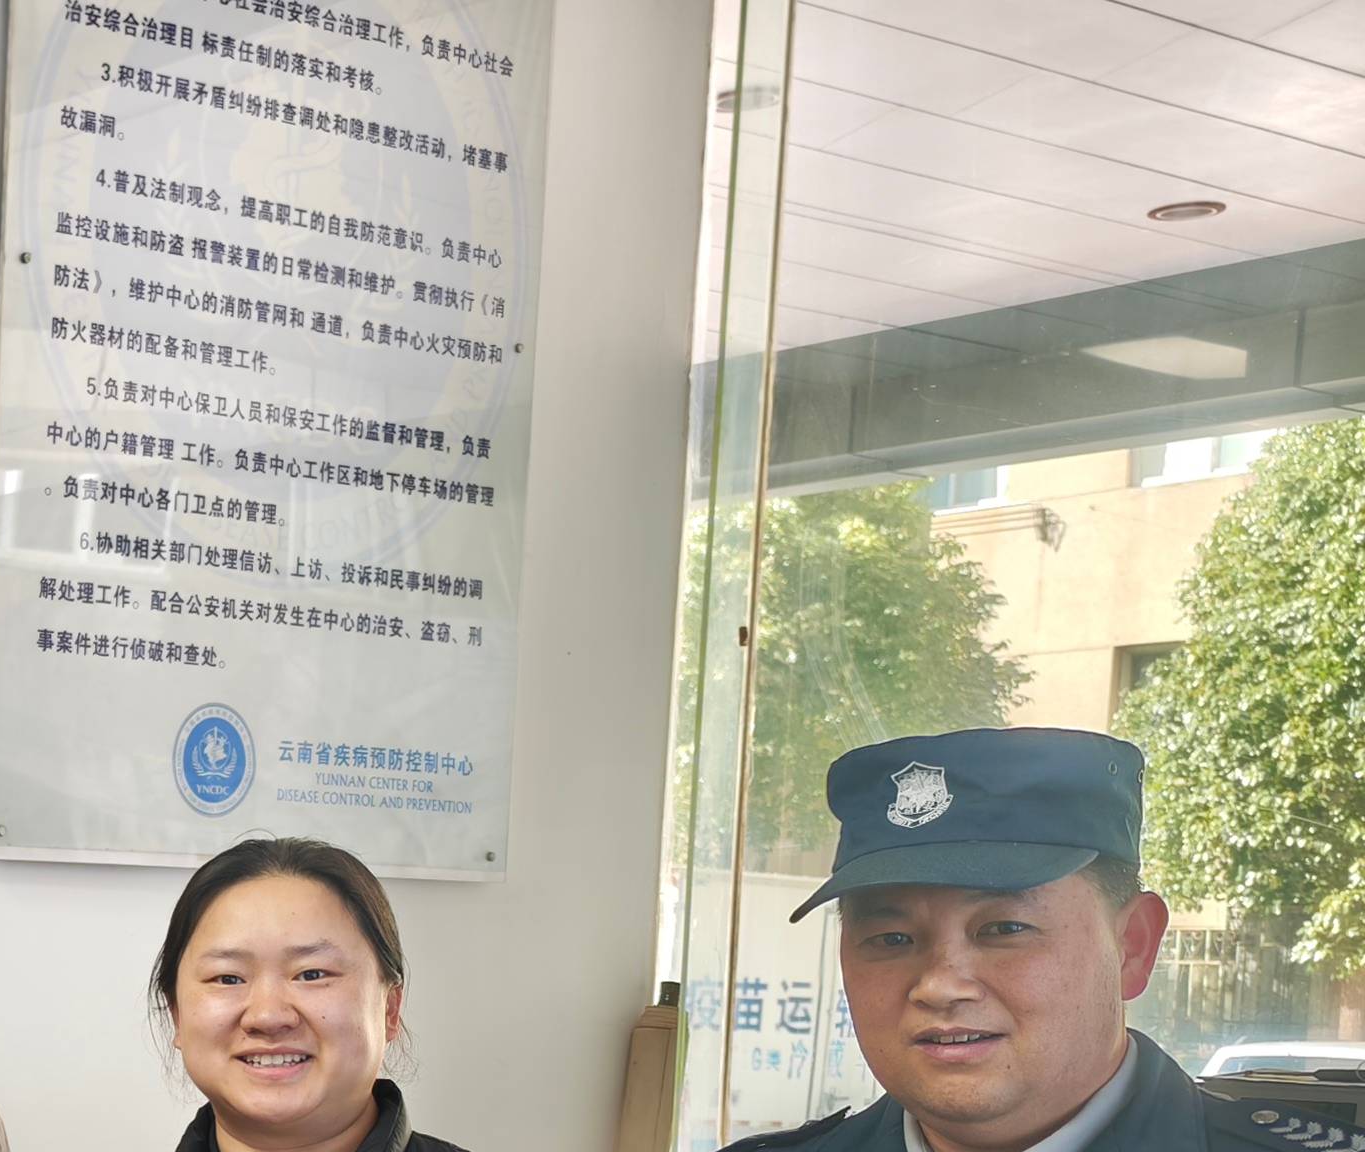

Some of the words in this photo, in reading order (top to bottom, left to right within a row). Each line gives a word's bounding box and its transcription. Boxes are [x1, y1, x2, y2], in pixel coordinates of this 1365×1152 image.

[202, 31, 383, 96] 标责任制的落实和考核。
[60, 106, 126, 141] 故漏洞。
[100, 62, 508, 173] 3.积极开展矛盾纠纷排查调处和隐患整改活动，堵塞事
[55, 212, 185, 257] 监控设施和防盗
[96, 169, 502, 268] 4.普及法制观念，提高职工的自我防范意识。负责中心
[51, 317, 276, 377] 防火器材的配备和管理工作。
[310, 311, 503, 365] 通道，负责中心火灾预防和
[86, 376, 492, 459] 5.负责对中心保卫人员和保安工作的监督和管理，负责
[47, 421, 175, 461] 中心的户籍管理
[181, 441, 496, 508] 工作。负责中心工作区和地下停车场的管理
[79, 530, 484, 601] 6.协助相关部门处理信访、上访、投诉和民事纠纷的调
[38, 576, 483, 648] 解处理工作。配合公安机关对发生在中心的治安、盗窃、刑
[36, 628, 227, 670] 事案件进行侦破和查处。
[277, 740, 474, 777] 云南省疾病预防控制中心
[315, 773, 365, 789] YUNNAN
[369, 776, 409, 791] CENTER
[412, 779, 434, 793] FOR
[196, 783, 230, 797] YNCDC
[277, 788, 319, 805] DISEASE
[322, 791, 375, 808] CONTROL
[379, 796, 403, 809] AND
[406, 797, 473, 814] PREVENTION
